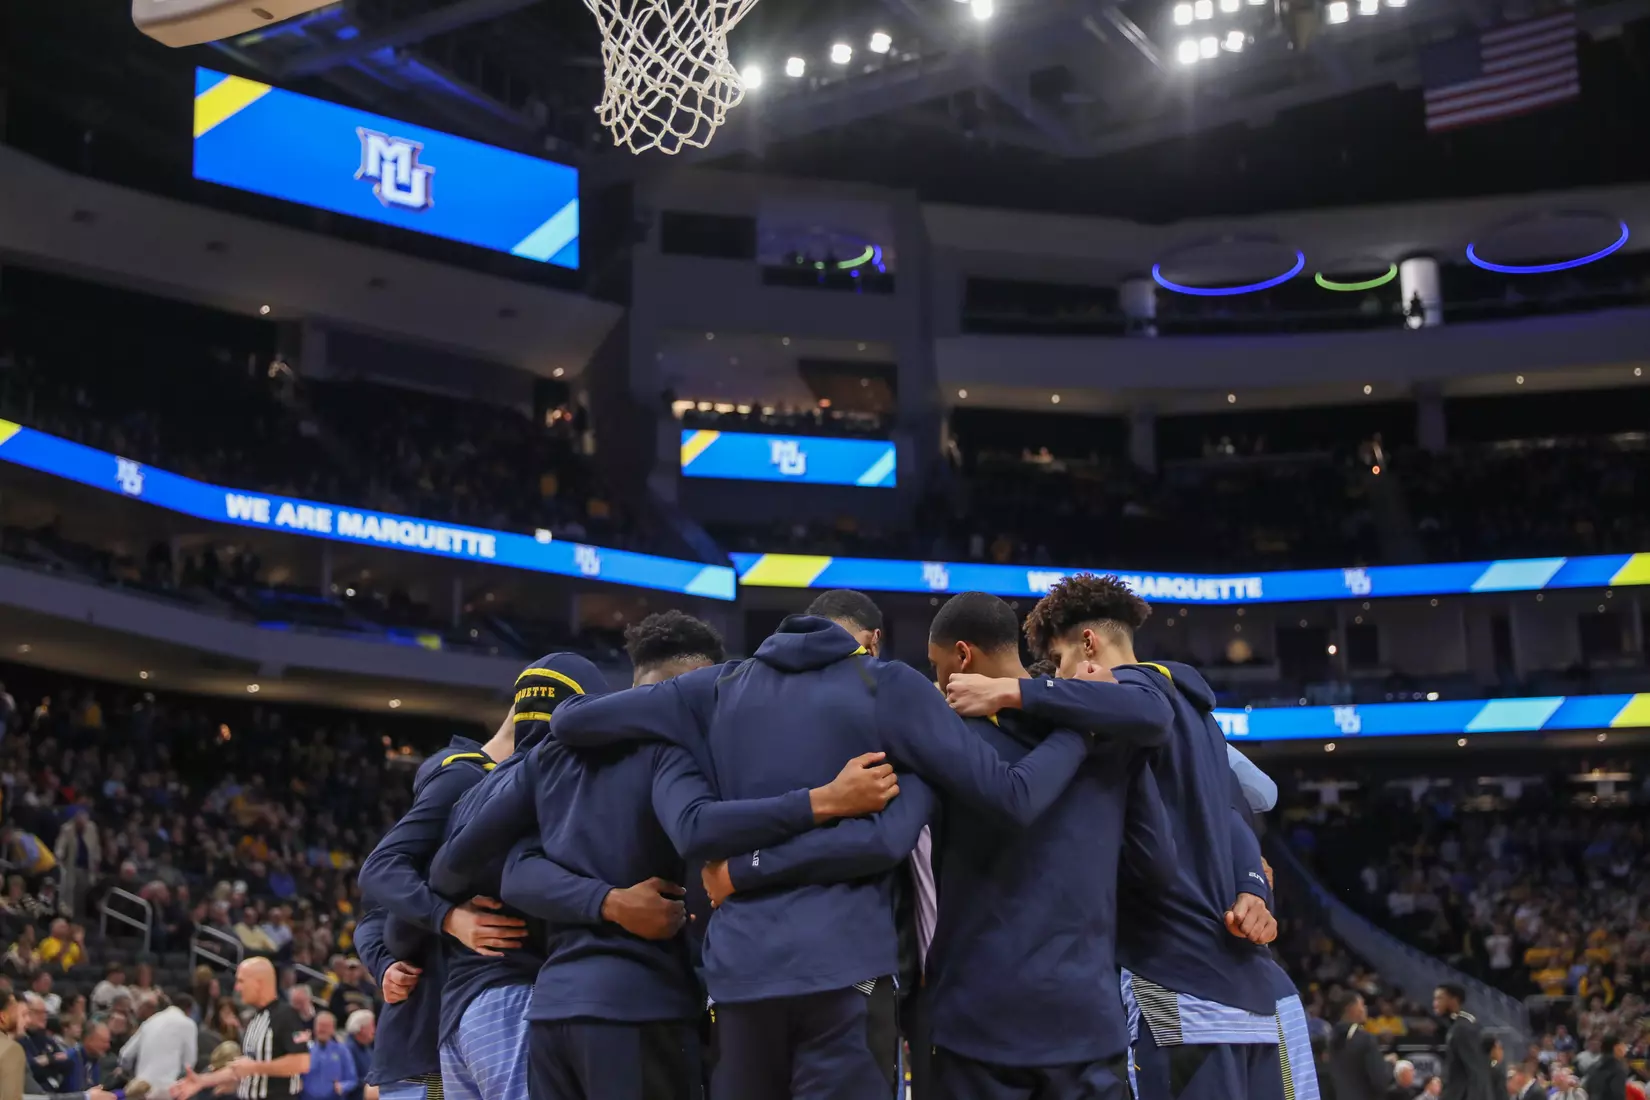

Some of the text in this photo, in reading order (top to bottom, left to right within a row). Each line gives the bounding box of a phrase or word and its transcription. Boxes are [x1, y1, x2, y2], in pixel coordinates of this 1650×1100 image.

[354, 126, 435, 210] MU
[769, 439, 807, 475] MU
[225, 493, 496, 558] WE ARE MARQUETTE
